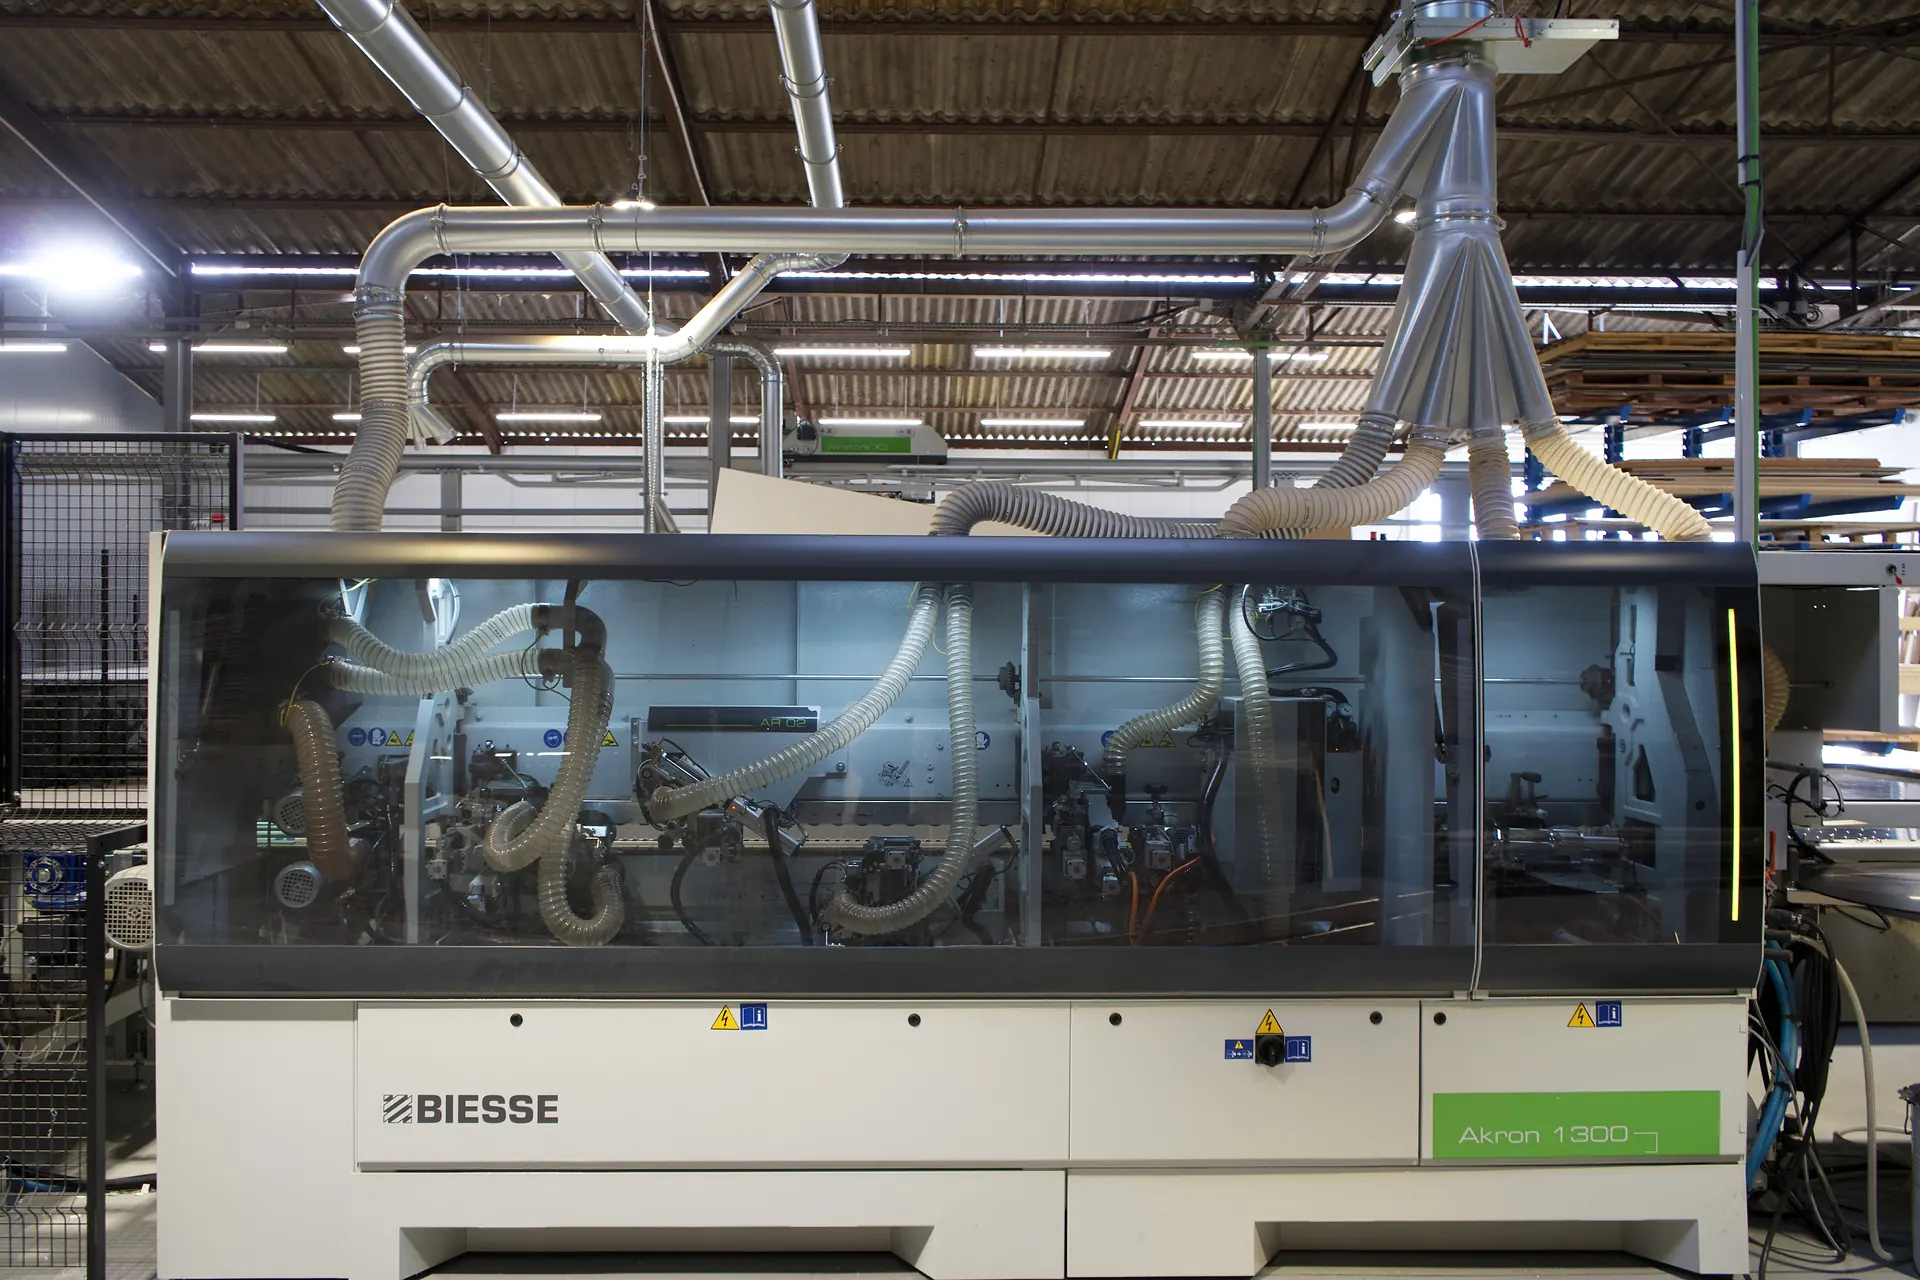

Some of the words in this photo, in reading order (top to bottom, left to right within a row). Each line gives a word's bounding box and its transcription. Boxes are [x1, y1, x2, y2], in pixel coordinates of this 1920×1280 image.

[760, 718, 781, 727] AR
[786, 718, 807, 728] 02
[417, 1095, 559, 1124] BIESSE
[1458, 1126, 1541, 1144] Akron
[1553, 1125, 1629, 1143] 1300
